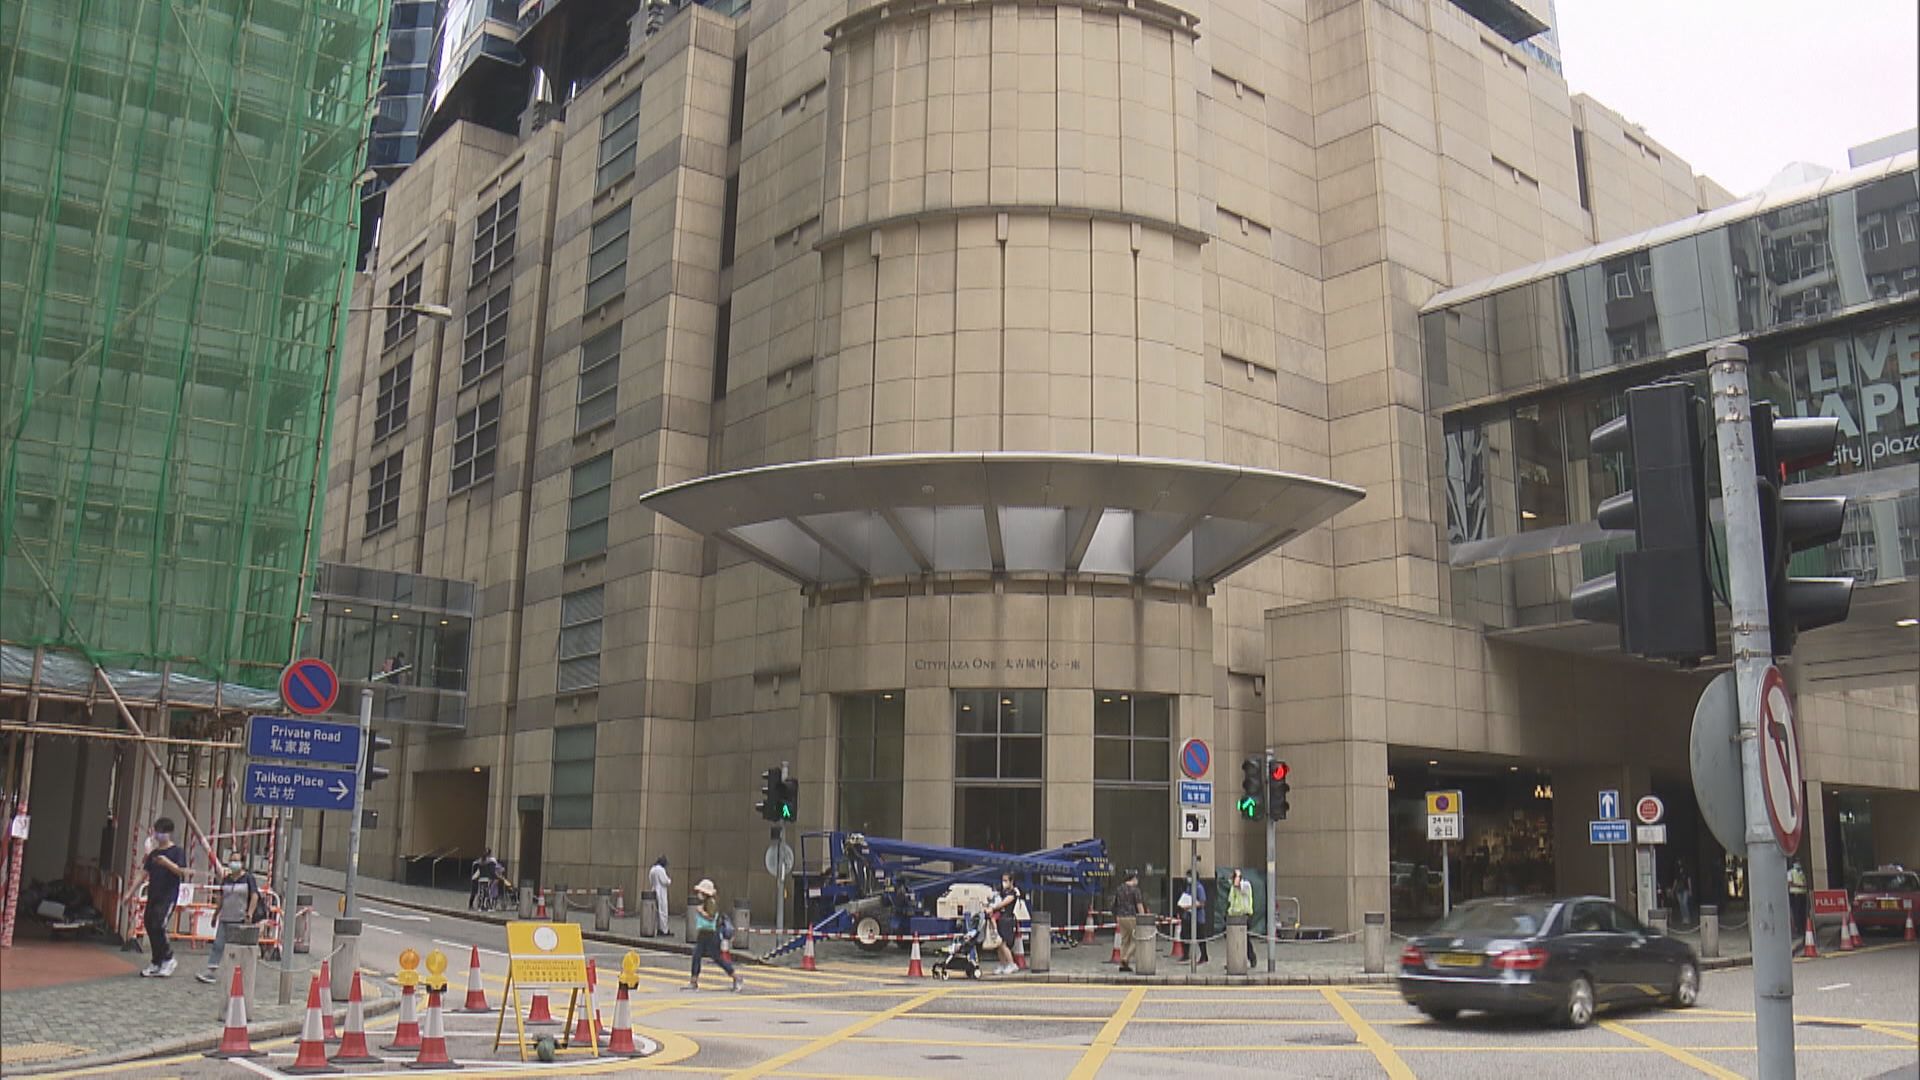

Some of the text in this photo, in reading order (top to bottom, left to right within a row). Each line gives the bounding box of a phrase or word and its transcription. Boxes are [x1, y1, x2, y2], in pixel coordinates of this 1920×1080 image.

[1806, 325, 1919, 393] LIVE
[271, 724, 341, 743] Private Road
[271, 739, 311, 755] 私家路
[254, 771, 324, 787] Taikoo Place
[254, 783, 295, 800] 太古坊
[1432, 816, 1441, 824] 24
[1434, 825, 1453, 837] 全日
